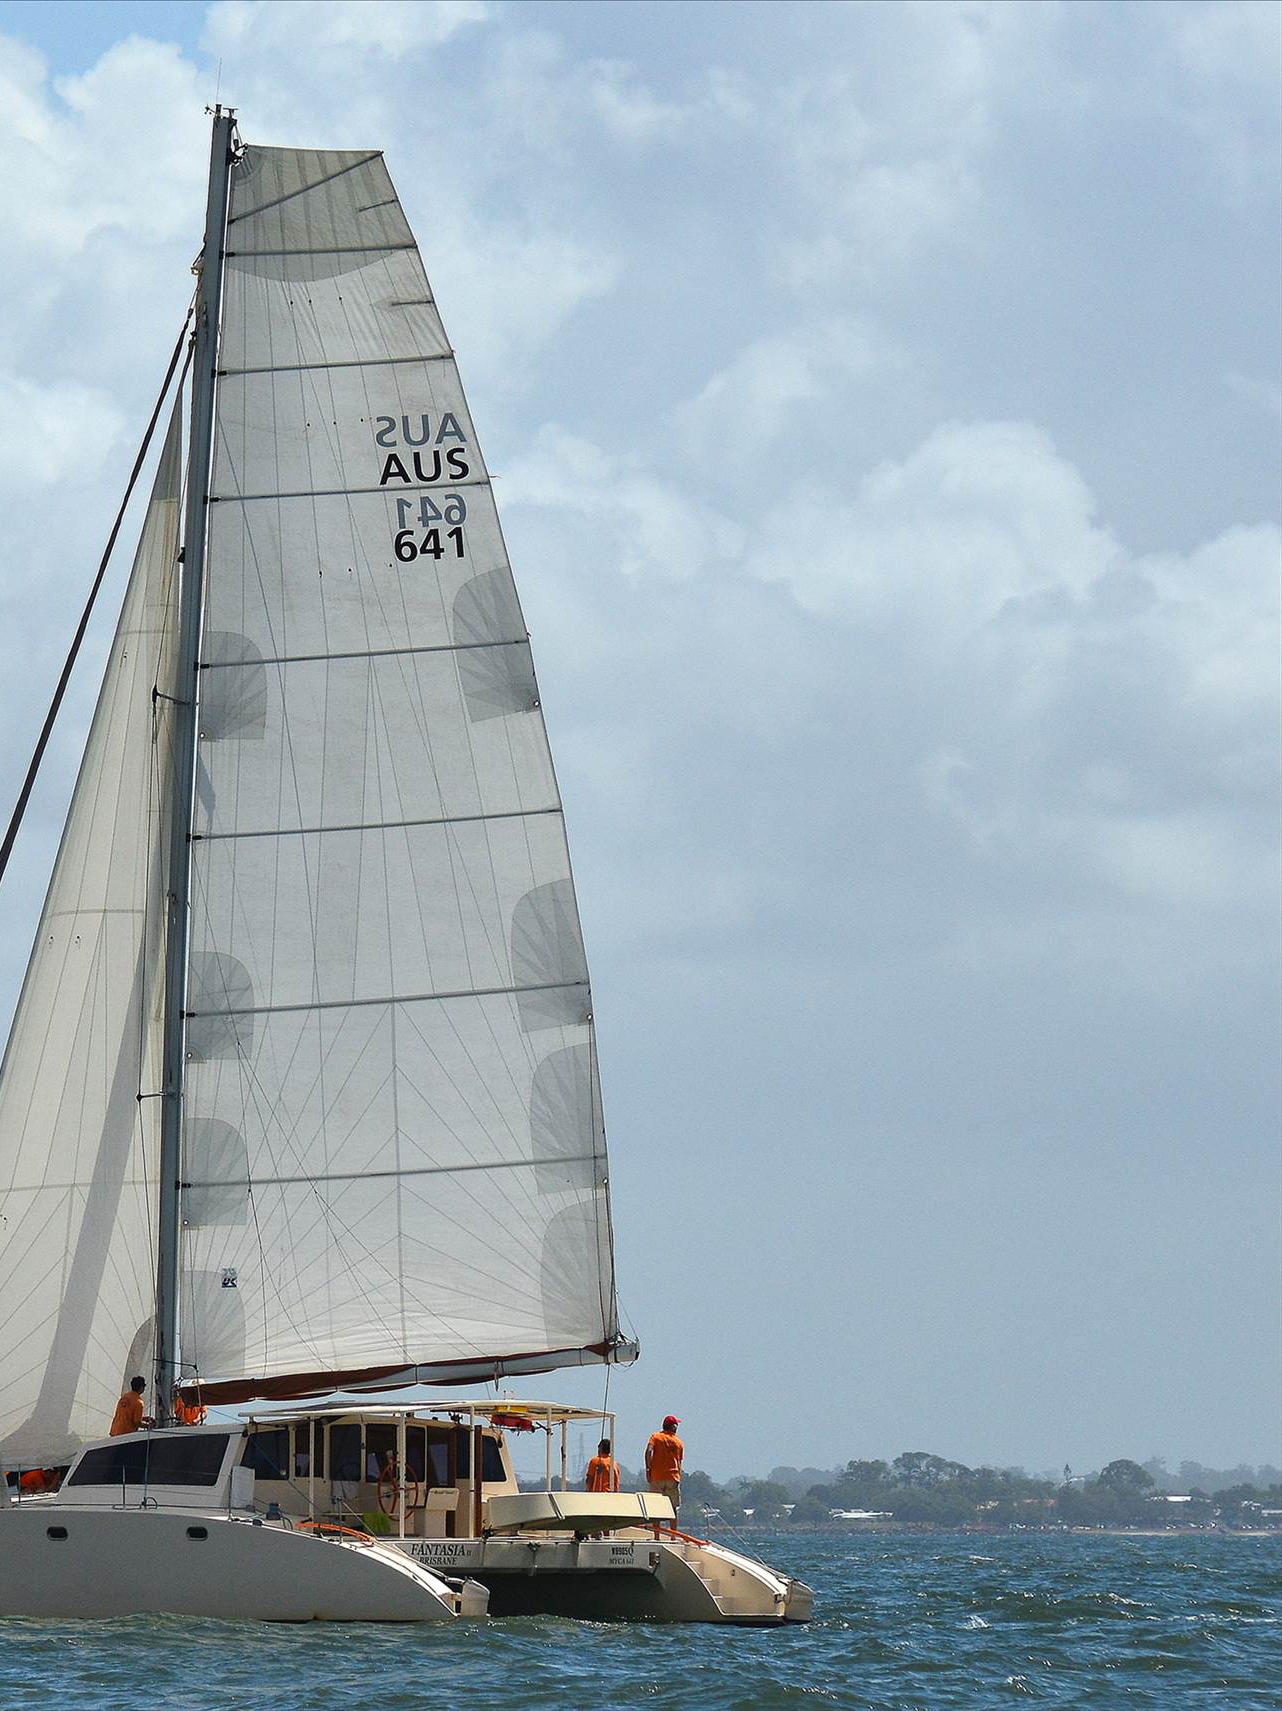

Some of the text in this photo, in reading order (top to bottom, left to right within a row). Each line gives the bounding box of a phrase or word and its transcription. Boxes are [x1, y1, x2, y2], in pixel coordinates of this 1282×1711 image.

[379, 447, 470, 486] AUS
[394, 526, 465, 562] 641
[410, 1543, 465, 1556] FANTASIA
[418, 1556, 457, 1566] BRISBANE
